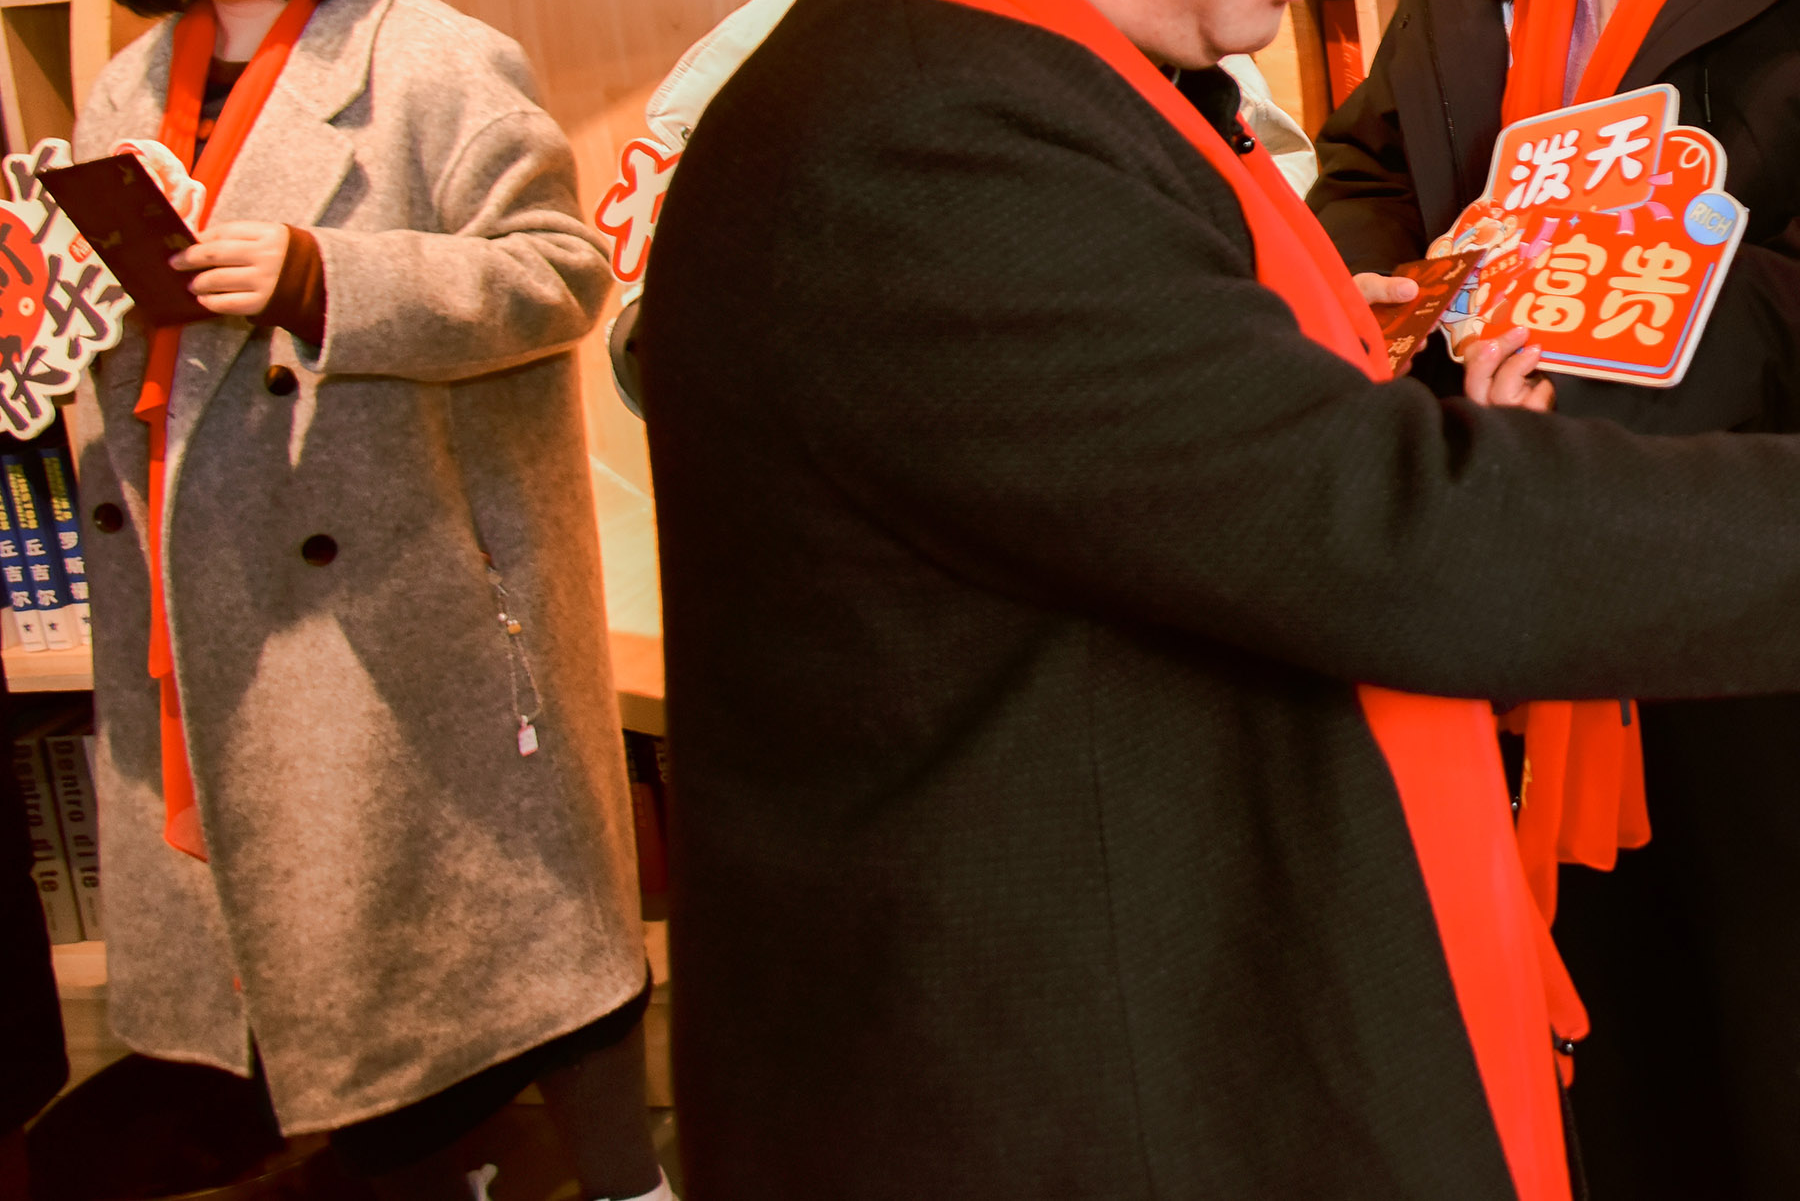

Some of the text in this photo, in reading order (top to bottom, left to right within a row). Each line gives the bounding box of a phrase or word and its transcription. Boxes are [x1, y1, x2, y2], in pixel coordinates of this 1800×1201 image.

[1505, 115, 1648, 211] 泼天
[1688, 202, 1733, 236] RICH
[1511, 233, 1691, 345] 富贵
[24, 539, 58, 606] 丘吉尔
